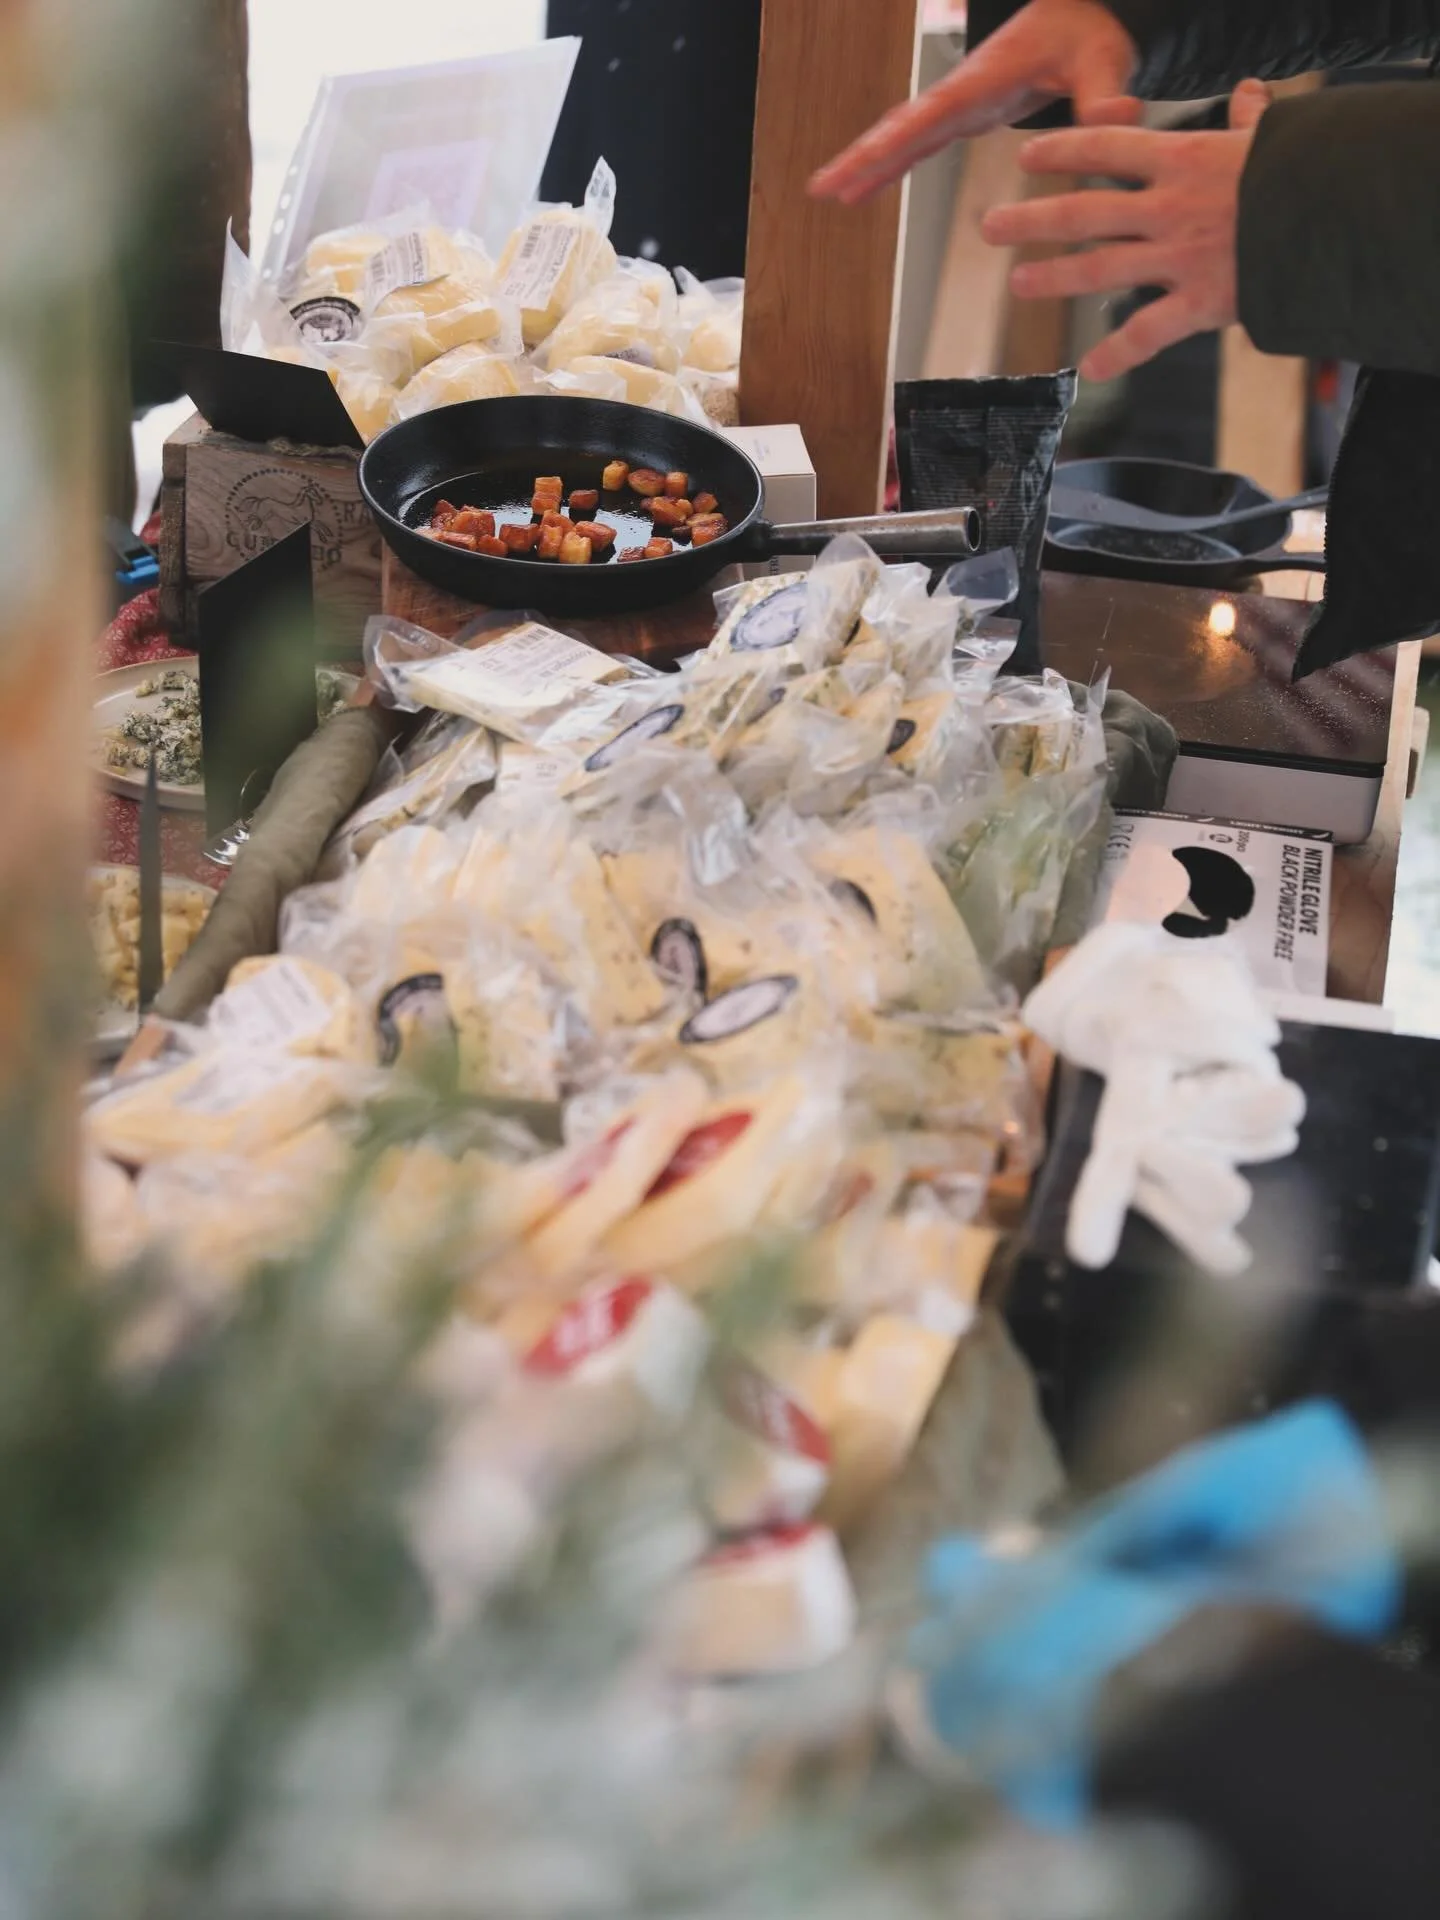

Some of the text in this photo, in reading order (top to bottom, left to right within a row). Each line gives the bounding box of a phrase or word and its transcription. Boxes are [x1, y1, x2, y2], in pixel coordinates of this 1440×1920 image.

[1273, 844, 1301, 962] BLACK POWDER FREE
[1298, 847, 1323, 936] NITRILE GLOVE
